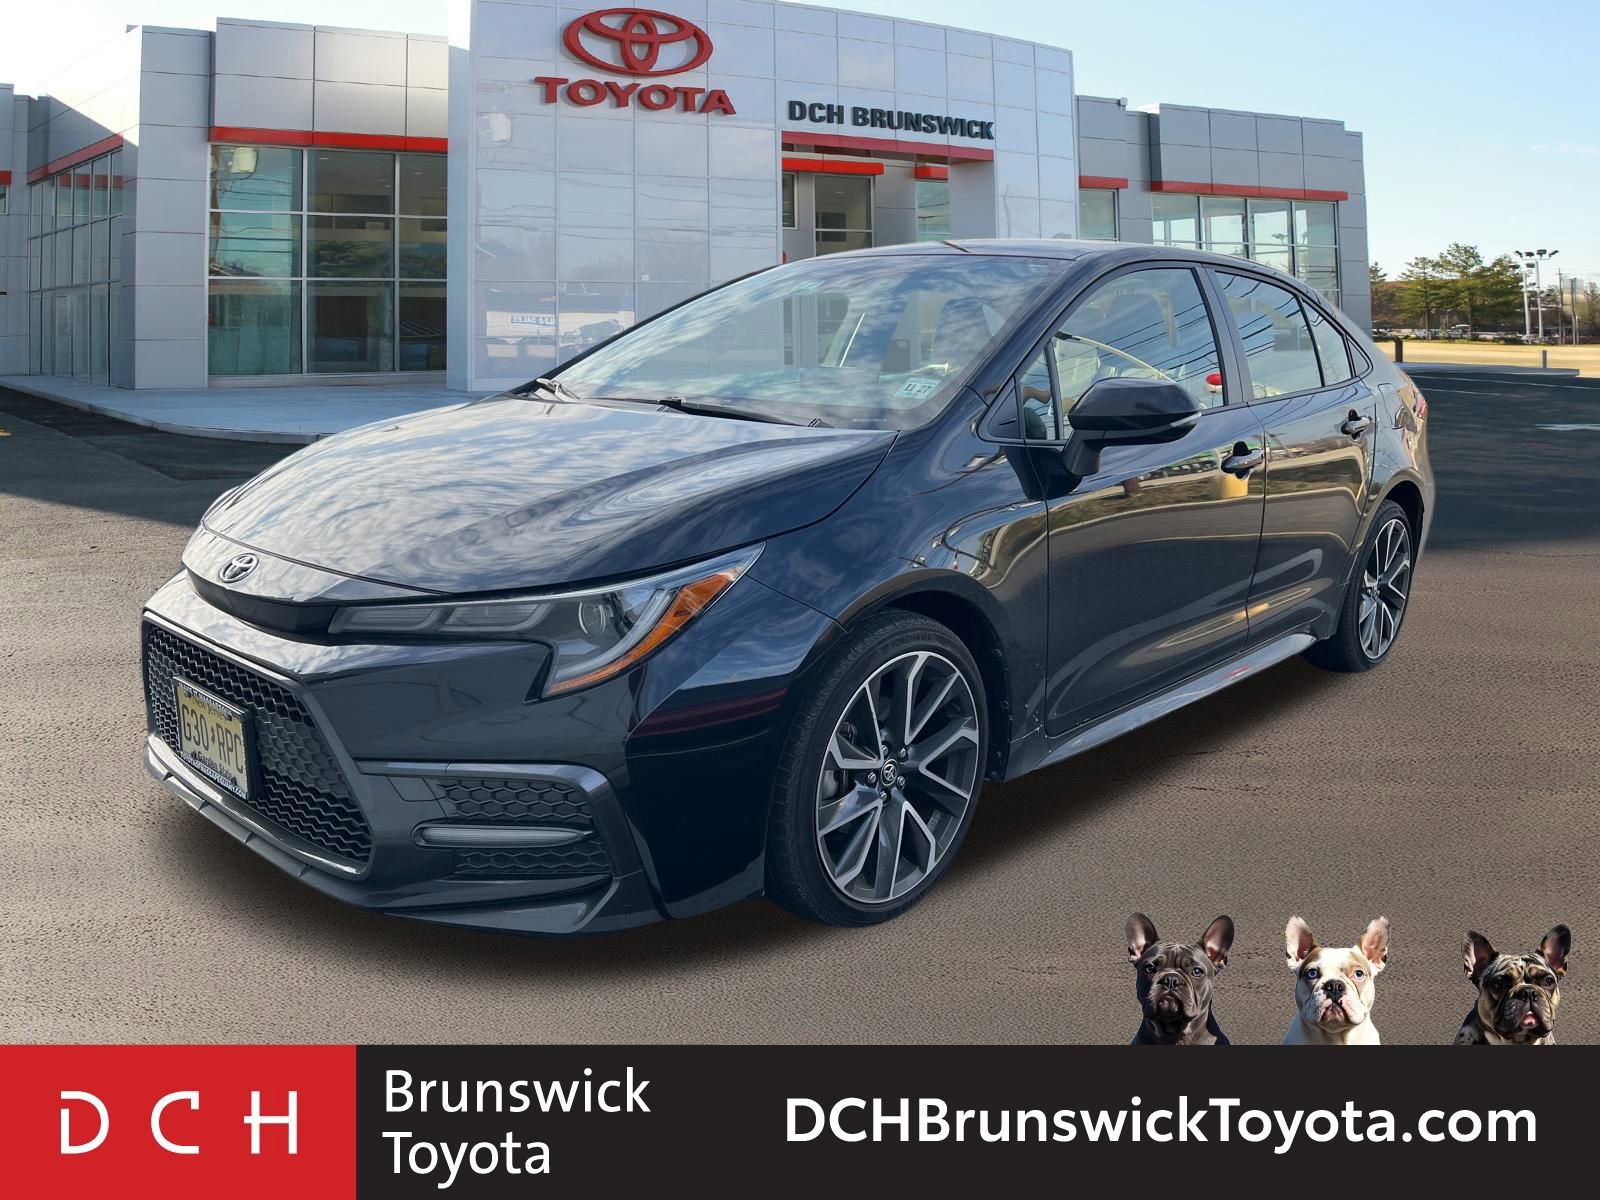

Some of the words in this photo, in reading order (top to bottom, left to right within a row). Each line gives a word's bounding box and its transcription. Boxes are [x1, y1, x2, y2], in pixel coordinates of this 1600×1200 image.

[535, 77, 735, 115] TOYOTA
[788, 99, 844, 125] DCH
[853, 107, 994, 140] BRUNSWICK
